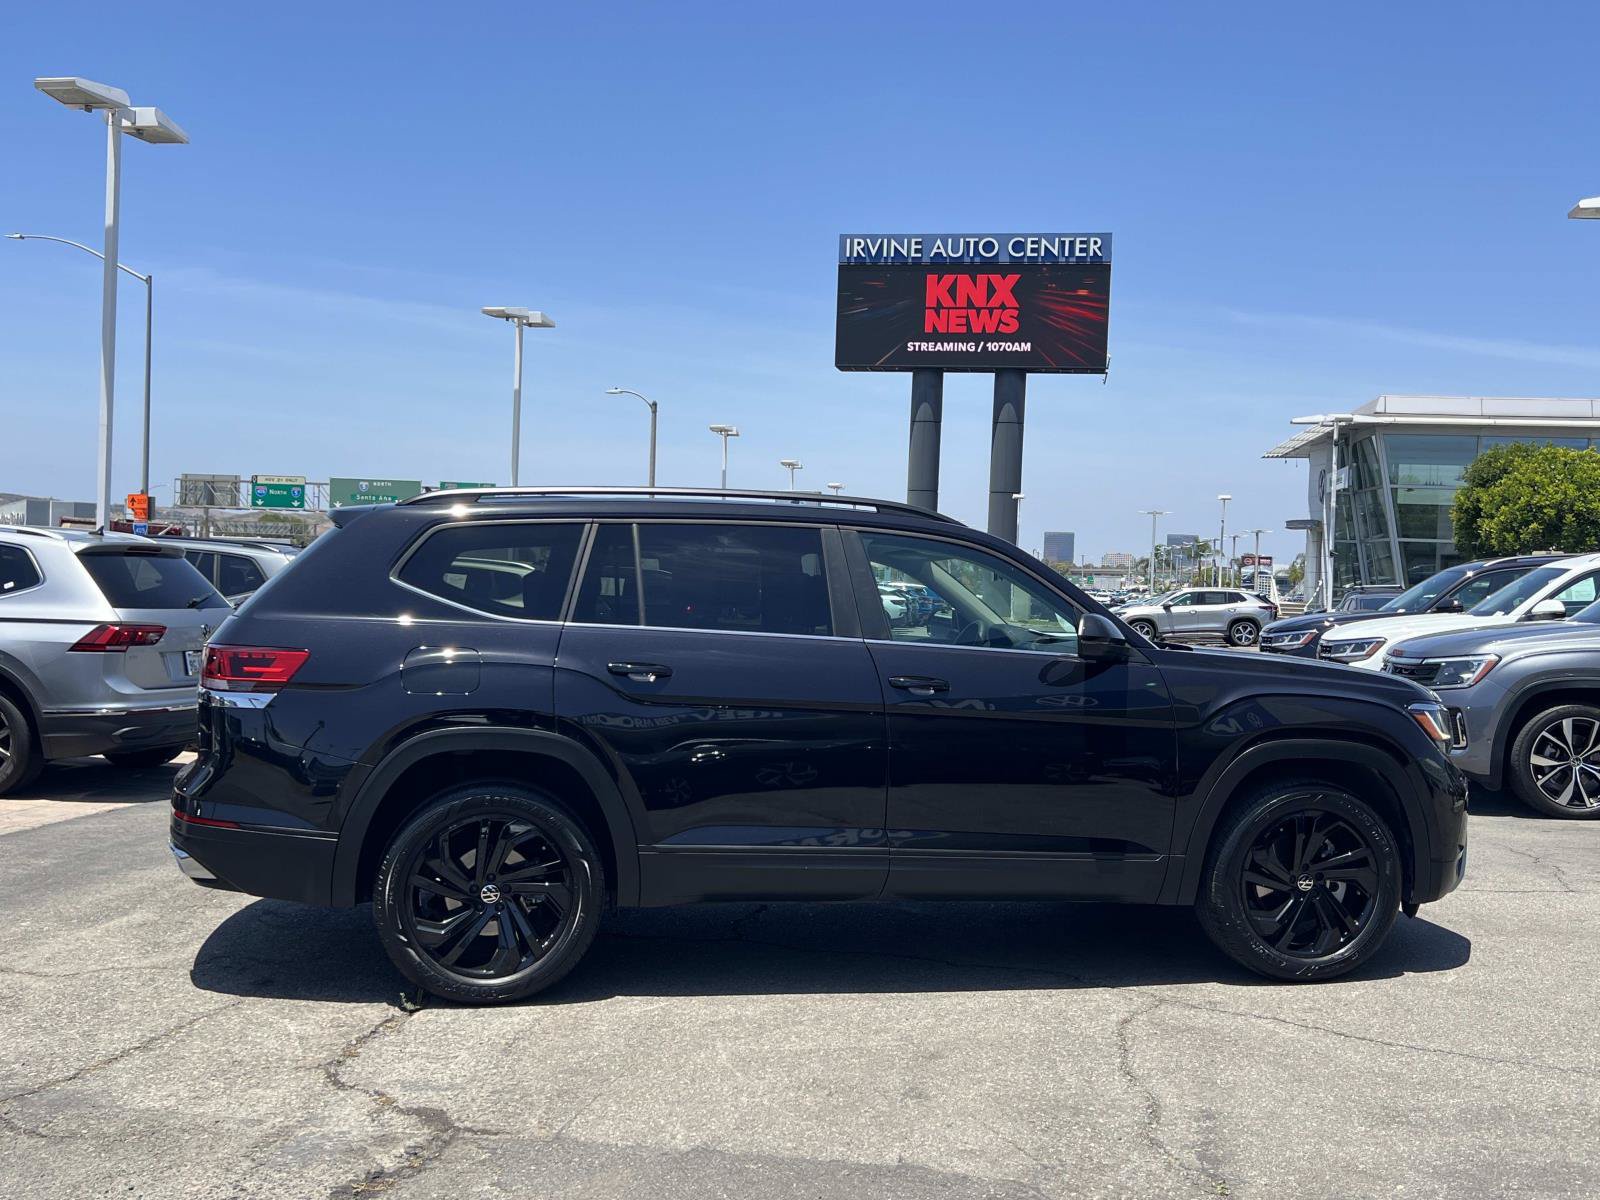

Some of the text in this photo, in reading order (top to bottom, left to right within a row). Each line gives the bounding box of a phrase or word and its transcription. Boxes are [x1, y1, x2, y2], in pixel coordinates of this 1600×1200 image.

[846, 237, 1103, 258] IRVINE AUTO CENTER
[925, 274, 1021, 308] KNX
[924, 308, 1020, 334] NEWS
[907, 341, 976, 352] STREAMING
[986, 341, 1032, 352] 1070AM
